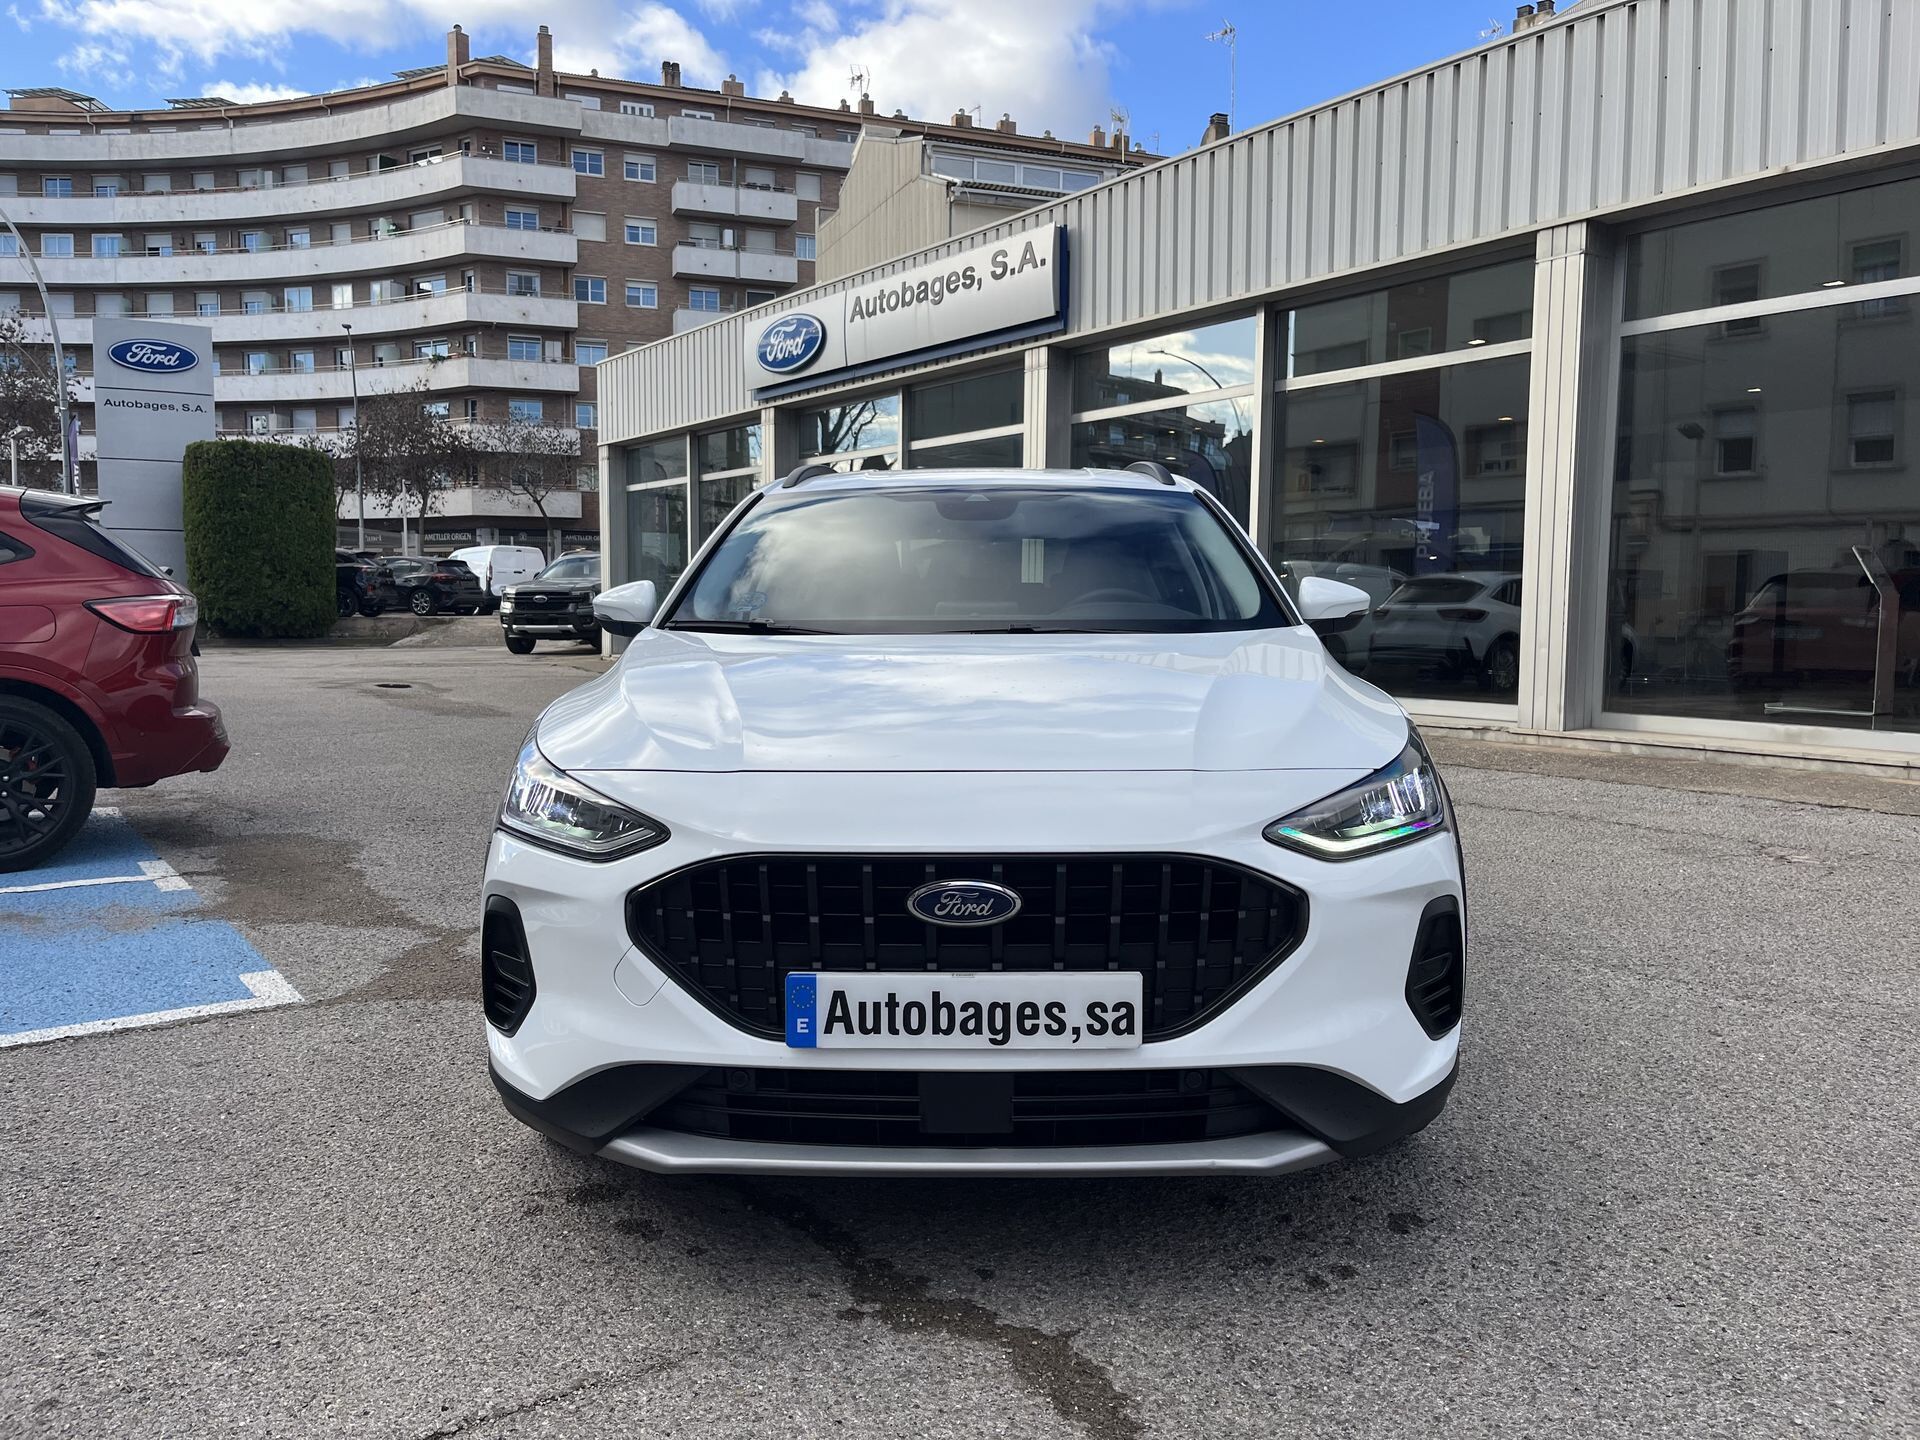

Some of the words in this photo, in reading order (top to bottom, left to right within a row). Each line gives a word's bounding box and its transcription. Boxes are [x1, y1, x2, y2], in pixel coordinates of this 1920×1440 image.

[850, 265, 982, 323] Autobages,
[990, 241, 1047, 281] S.A.
[126, 343, 180, 366] Ford
[766, 323, 807, 362] Ford
[104, 398, 179, 412] Autobages,
[181, 403, 207, 414] S.A.
[451, 533, 472, 541] ORIGEN
[934, 891, 995, 916] Ford
[796, 1018, 809, 1033] E
[823, 990, 1136, 1046] Autobages,sa
